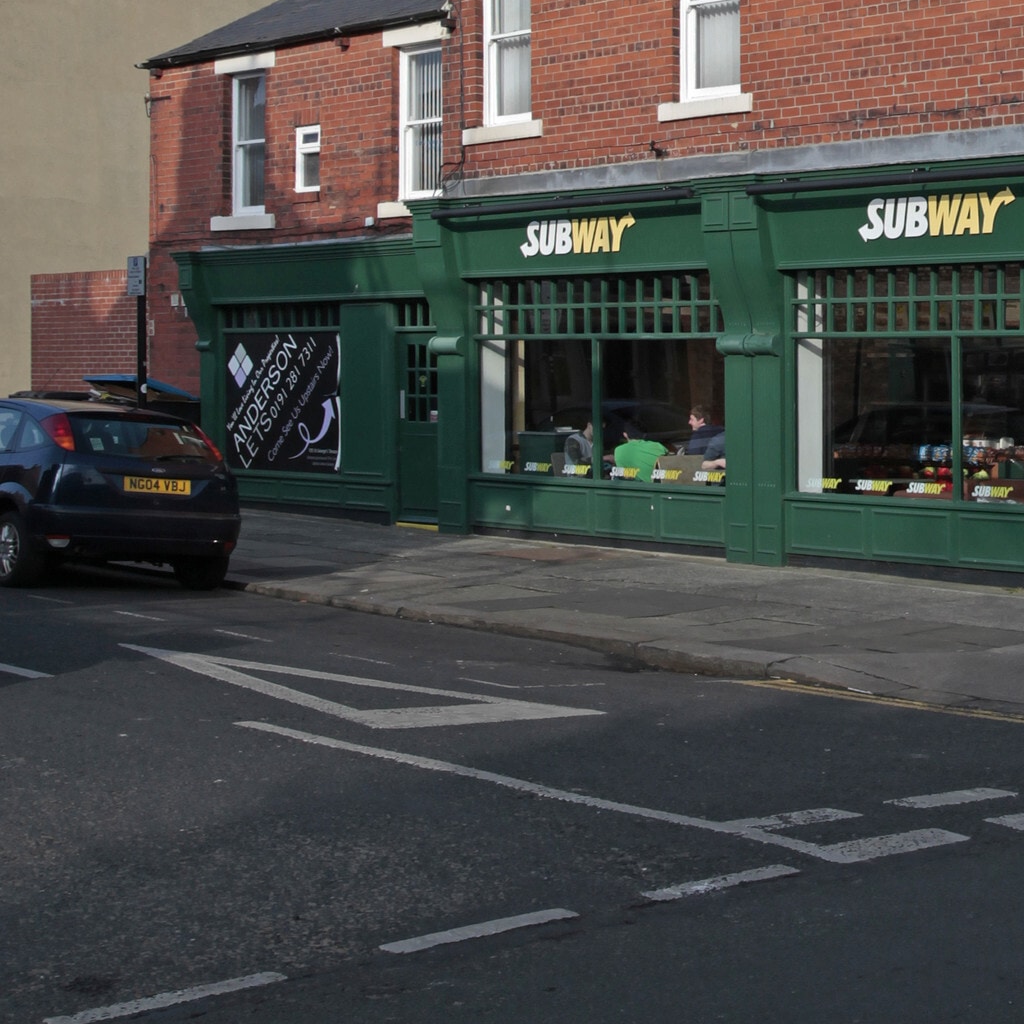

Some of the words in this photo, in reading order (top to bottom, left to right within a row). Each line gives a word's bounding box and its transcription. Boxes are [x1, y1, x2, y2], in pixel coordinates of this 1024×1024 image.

[857, 186, 1016, 243] SUBWAY
[520, 211, 636, 258] SUBWAY
[270, 388, 288, 418] 0191
[285, 365, 301, 391] 281
[298, 337, 316, 367] 7311
[234, 334, 298, 452] ANDERSON
[268, 435, 285, 461] Come
[282, 419, 294, 436] See
[291, 405, 301, 419] Us
[298, 373, 320, 406] Upstairs
[316, 345, 335, 374] Now!
[239, 412, 272, 468] LETS
[524, 462, 552, 472] SUBWAY
[561, 464, 591, 475] SUBWAY
[610, 466, 640, 478] SUBWAY
[651, 469, 682, 480] SUBWAY
[693, 471, 725, 482] SUBWAY
[129, 478, 160, 490] NG04
[164, 480, 186, 492] VBJ
[806, 478, 842, 489] SUBWAY
[855, 479, 893, 492] SUBWAY
[906, 482, 946, 494] SUBWAY
[972, 485, 1014, 498] SUBWAY
